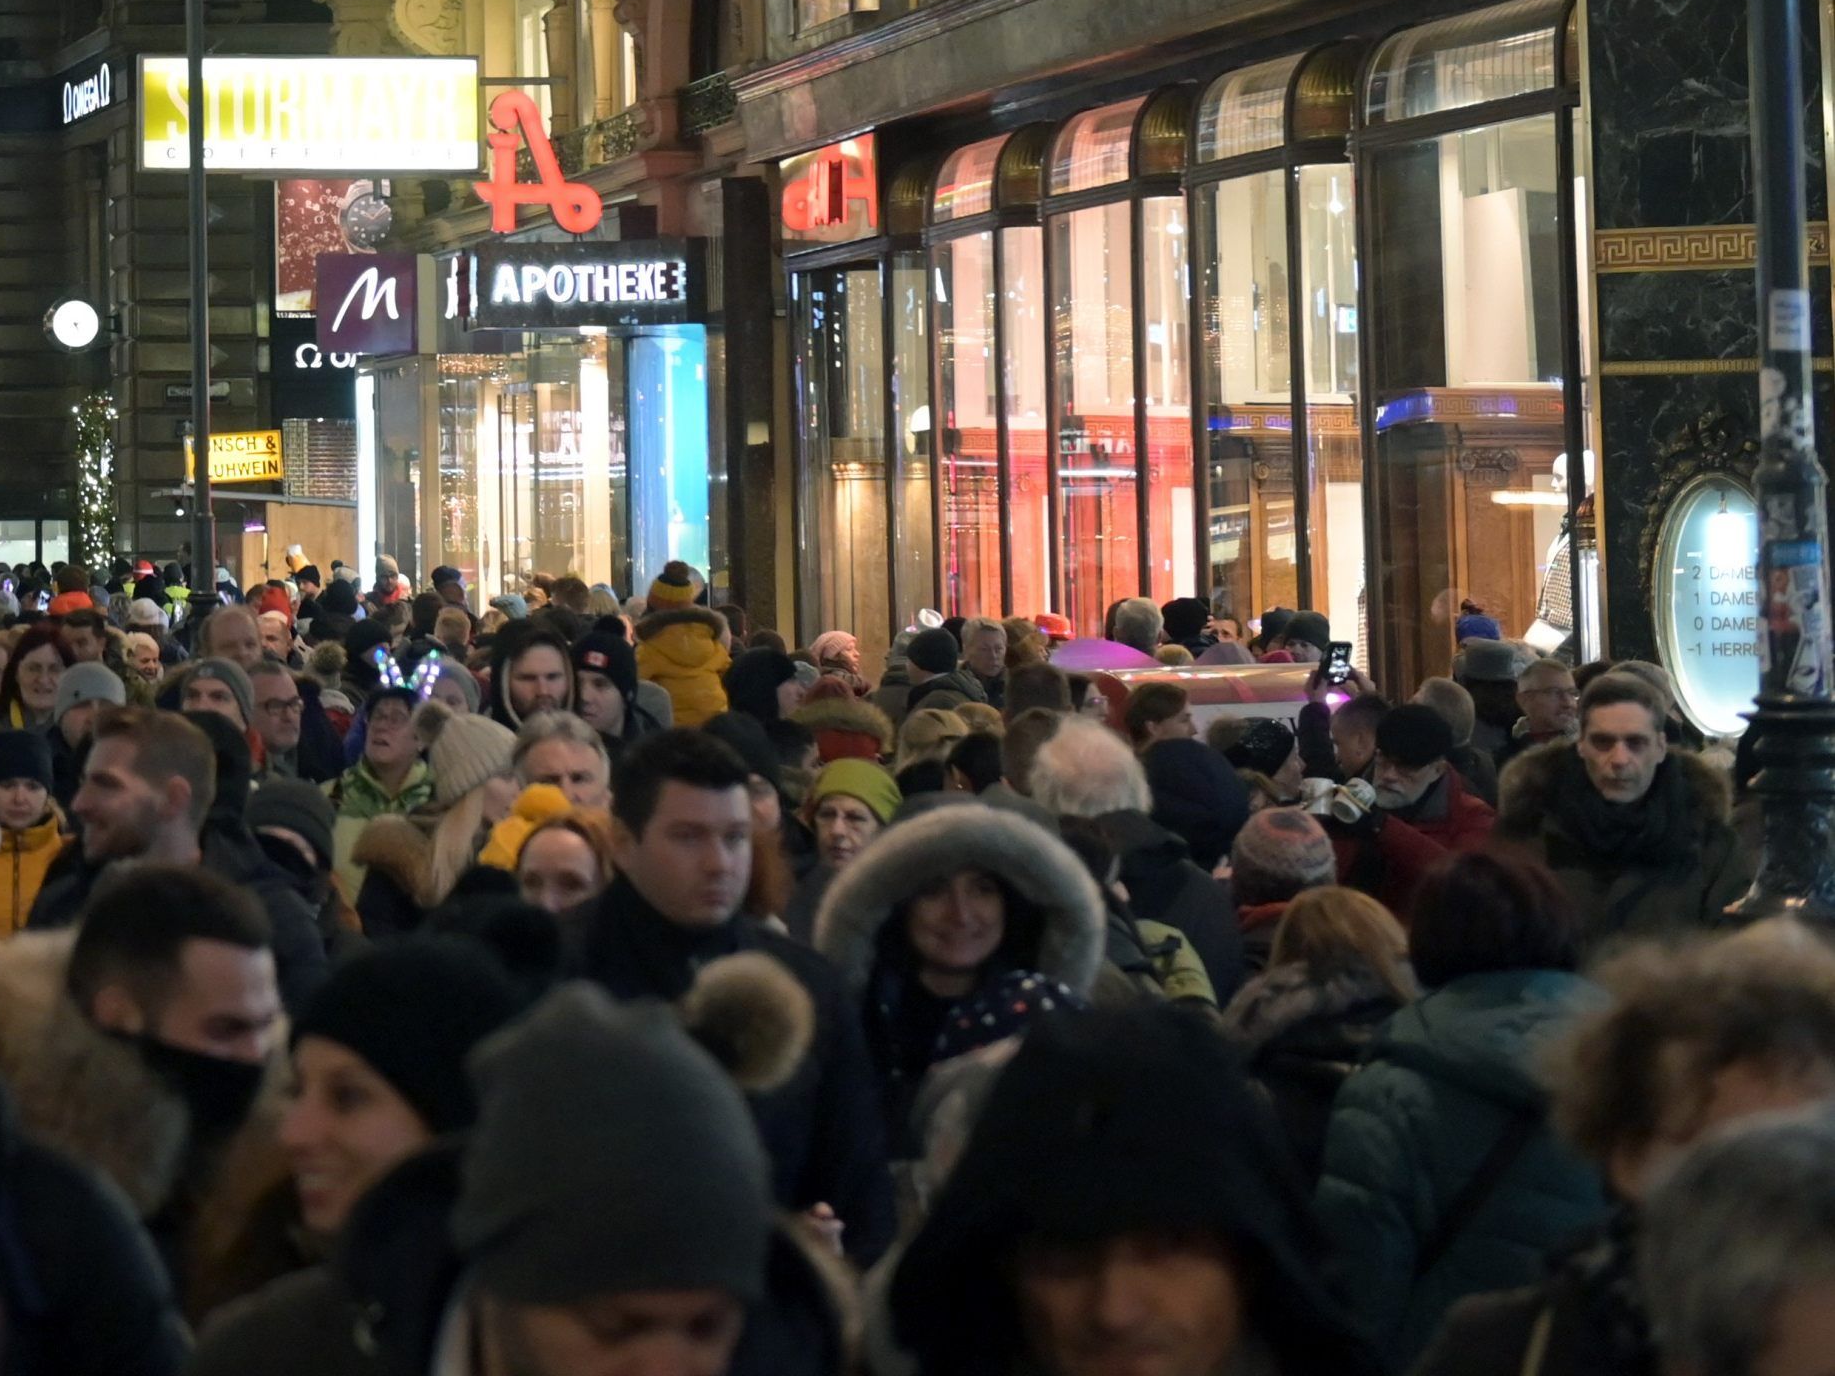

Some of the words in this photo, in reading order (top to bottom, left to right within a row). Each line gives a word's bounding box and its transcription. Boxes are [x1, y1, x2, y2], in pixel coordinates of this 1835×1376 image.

[72, 73, 100, 120] OMEGA
[492, 261, 668, 303] APOTHEKE
[331, 266, 400, 333] M
[212, 436, 257, 453] NSCH
[266, 435, 276, 450] &
[211, 460, 278, 478] UHWEIN
[1692, 565, 1702, 580] 2
[1709, 566, 1756, 580] DAME
[1694, 591, 1700, 605] 1
[1710, 591, 1757, 605] DAME
[1711, 616, 1758, 631] DAME
[1712, 642, 1766, 657] HERRE
